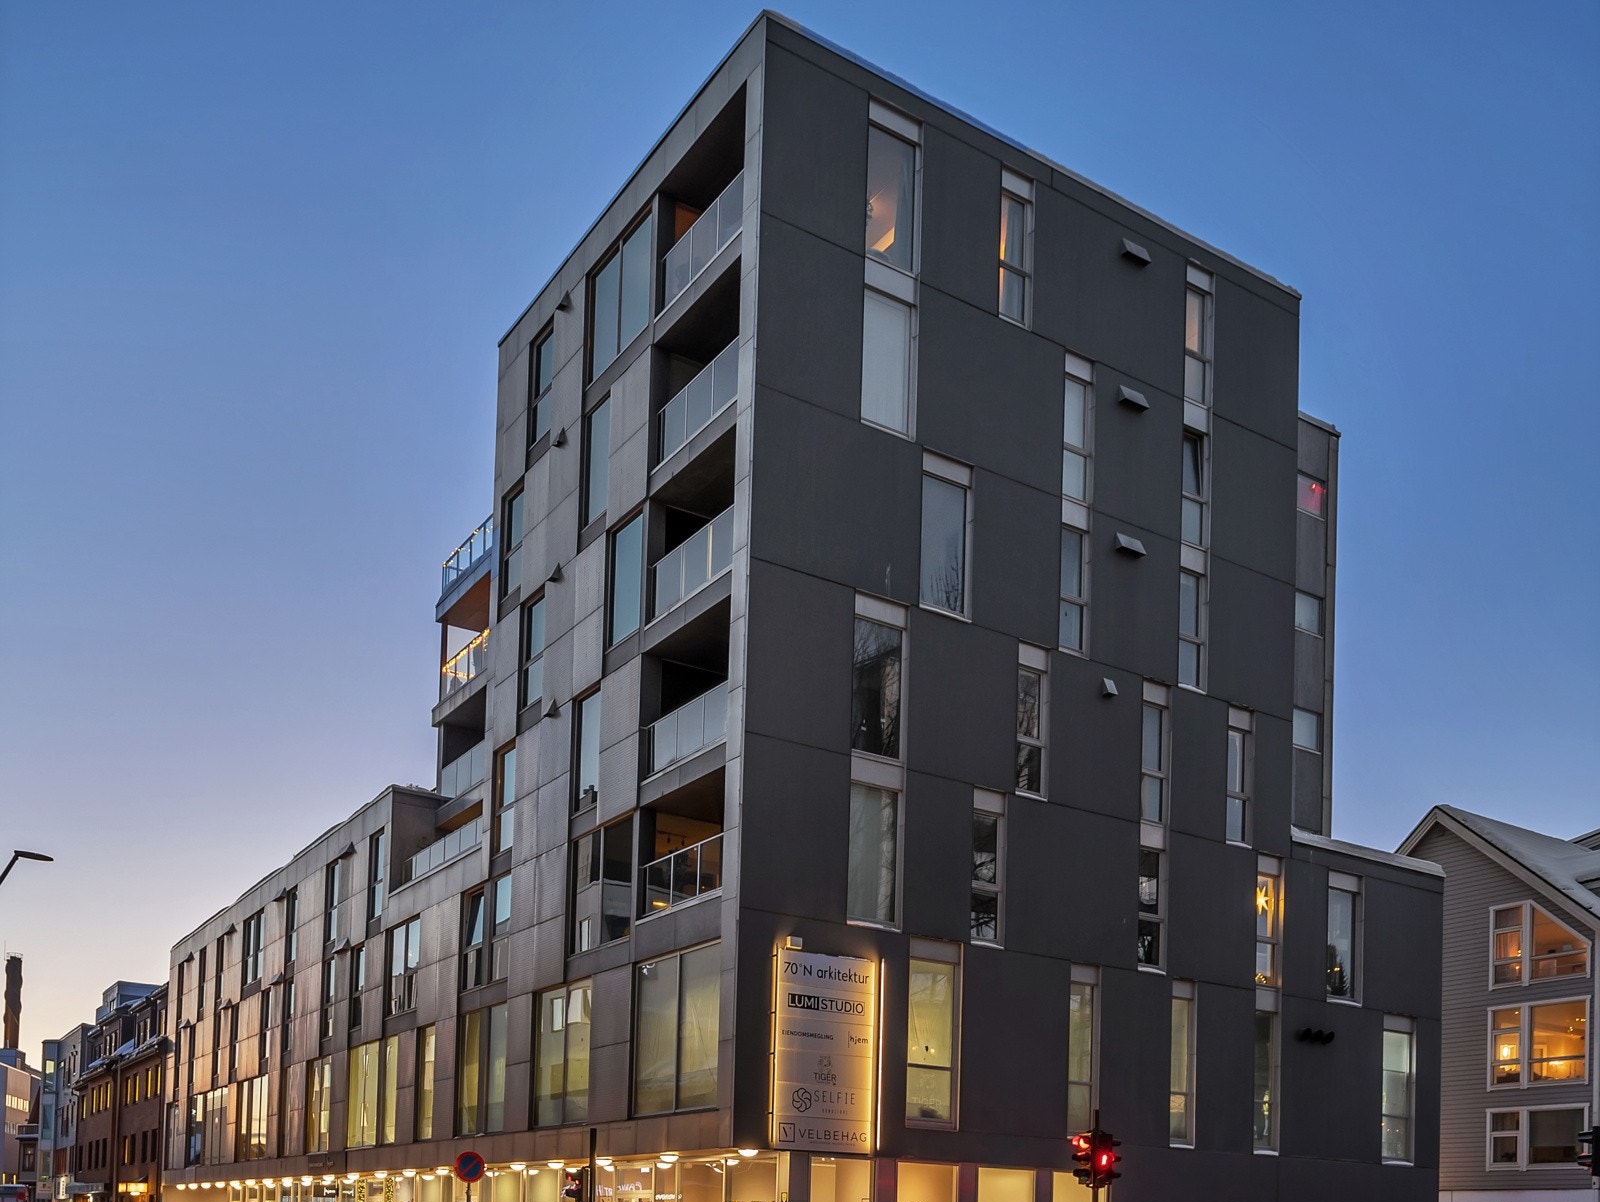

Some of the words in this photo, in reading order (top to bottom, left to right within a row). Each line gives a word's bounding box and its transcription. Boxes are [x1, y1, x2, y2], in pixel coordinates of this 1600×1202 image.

[816, 965, 870, 985] arkitektur
[781, 1029, 834, 1041] EIENDOMSMEGLING
[813, 1072, 837, 1083] TIGER
[813, 1090, 856, 1105] SELFIE
[798, 1128, 867, 1142] VELBEHAG
